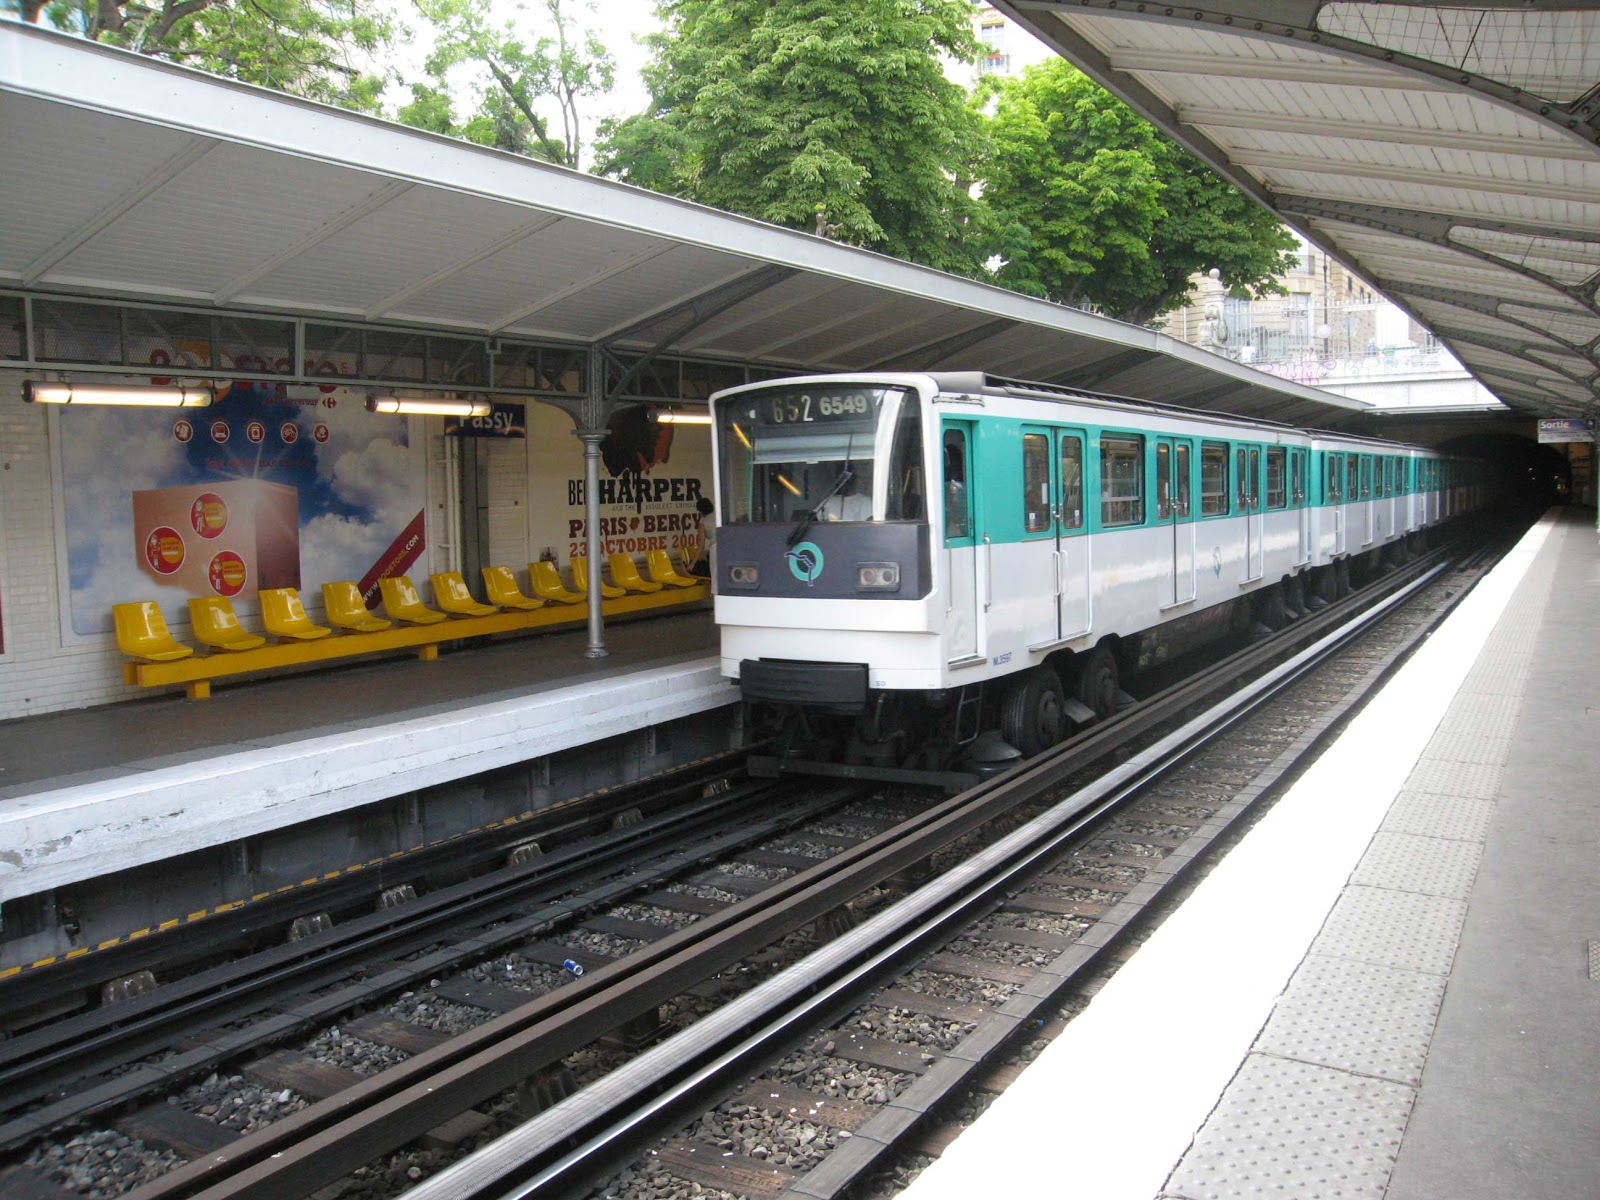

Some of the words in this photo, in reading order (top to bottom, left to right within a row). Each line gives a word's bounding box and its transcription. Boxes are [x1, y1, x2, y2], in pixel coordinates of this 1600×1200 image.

[820, 395, 867, 416] 6549
[459, 411, 514, 435] Passy
[1540, 420, 1569, 429] Sortie
[568, 479, 588, 506] BE
[598, 477, 702, 505] HARPER
[568, 516, 628, 538] PRIS
[643, 512, 701, 533] BERCY
